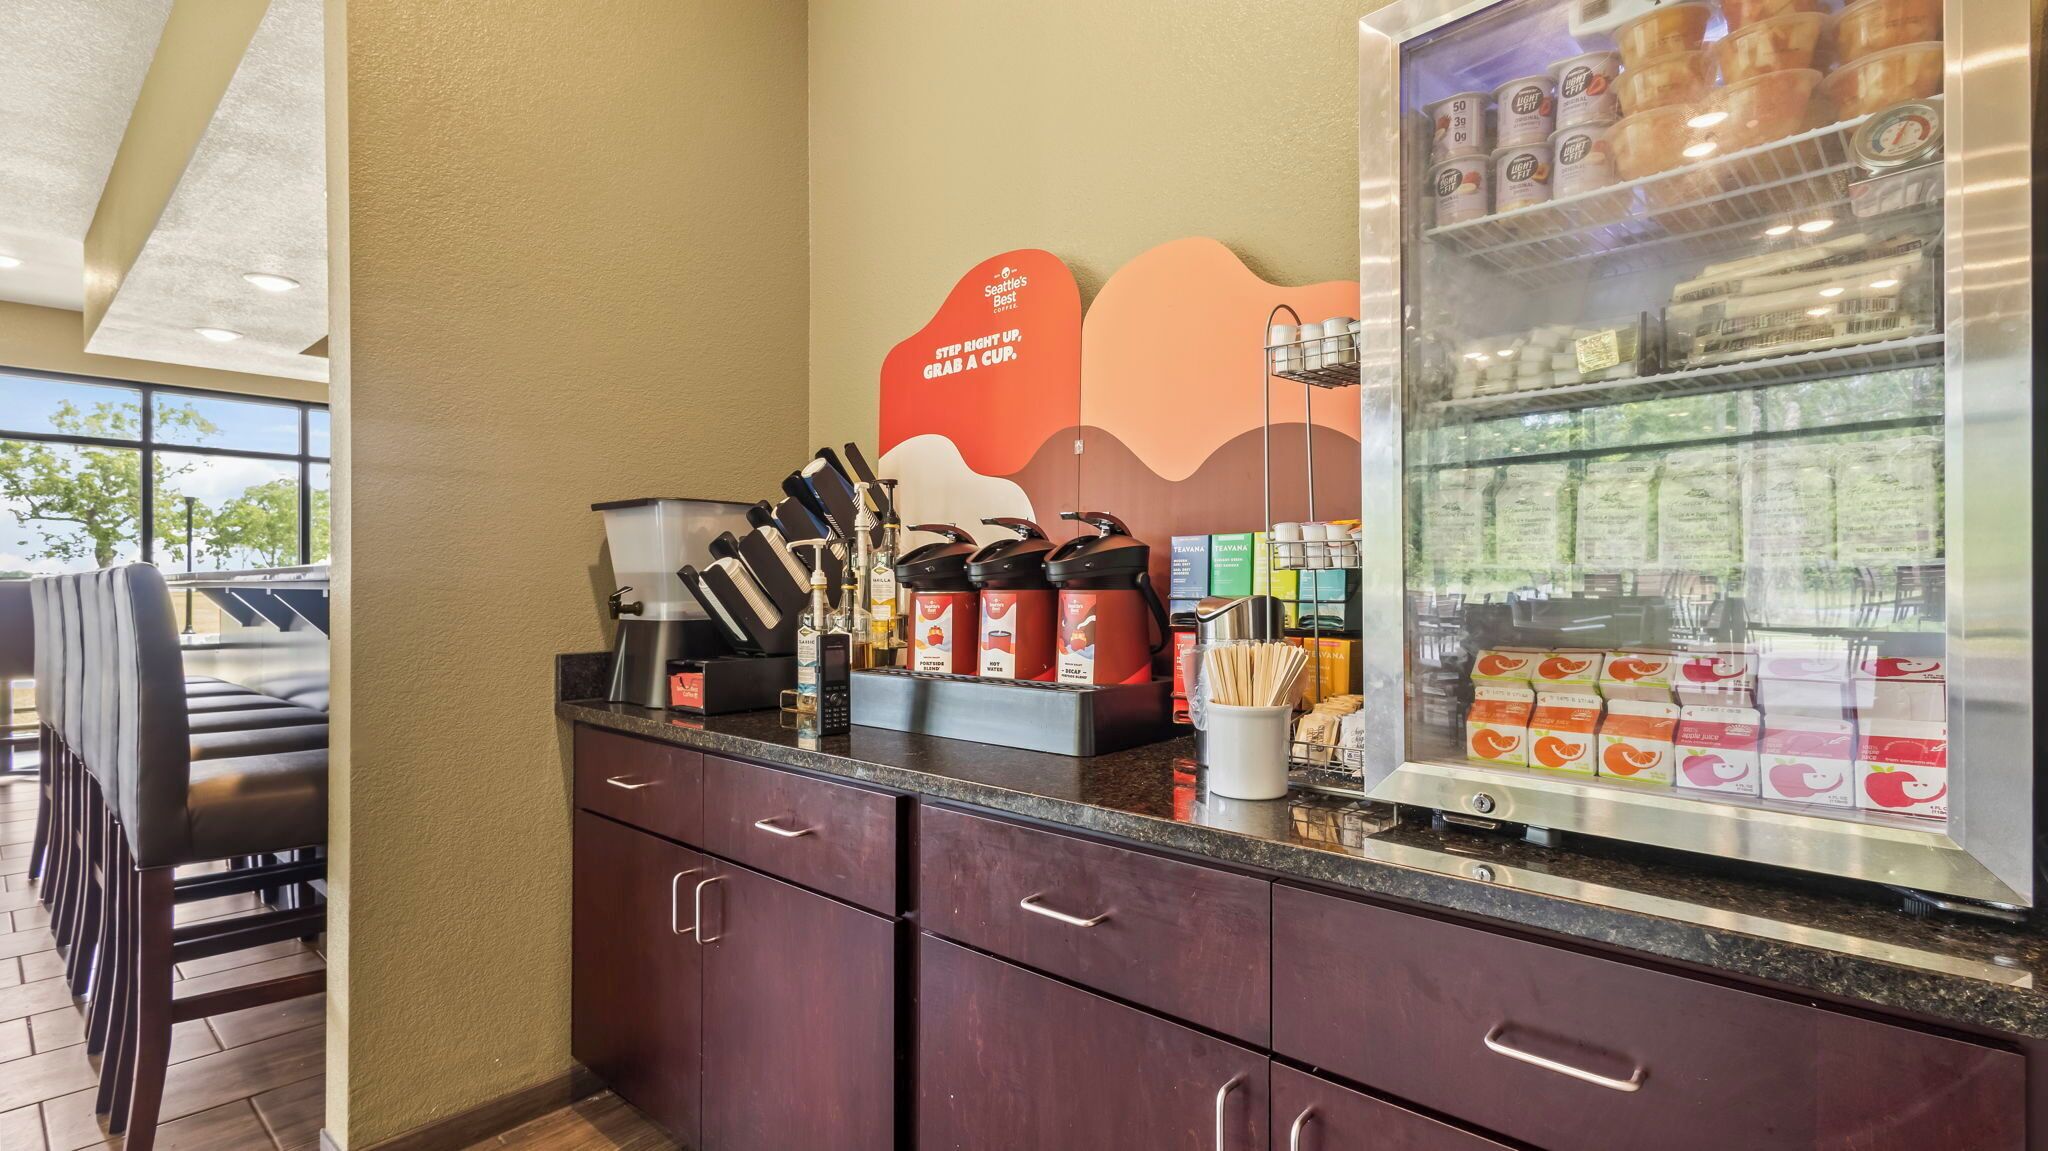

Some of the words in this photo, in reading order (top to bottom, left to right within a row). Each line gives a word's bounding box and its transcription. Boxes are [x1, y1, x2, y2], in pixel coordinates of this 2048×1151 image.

[1516, 93, 1540, 106] LIGHT
[1453, 100, 1466, 112] 50
[1454, 117, 1466, 127] 3g
[1454, 132, 1467, 142] 0g
[1511, 161, 1535, 174] LIGHT
[984, 276, 1027, 297] Seattle's
[993, 291, 1017, 307] Best
[993, 304, 1017, 314] COFFEE
[935, 343, 962, 360] STEP
[963, 333, 1000, 353] RIGHT
[1002, 329, 1022, 343] UP,
[923, 358, 963, 379] GRAB
[966, 354, 978, 370] A
[981, 345, 1017, 366] CUP.
[1173, 545, 1205, 553] TEAVANA
[1214, 544, 1248, 552] TEAVANA
